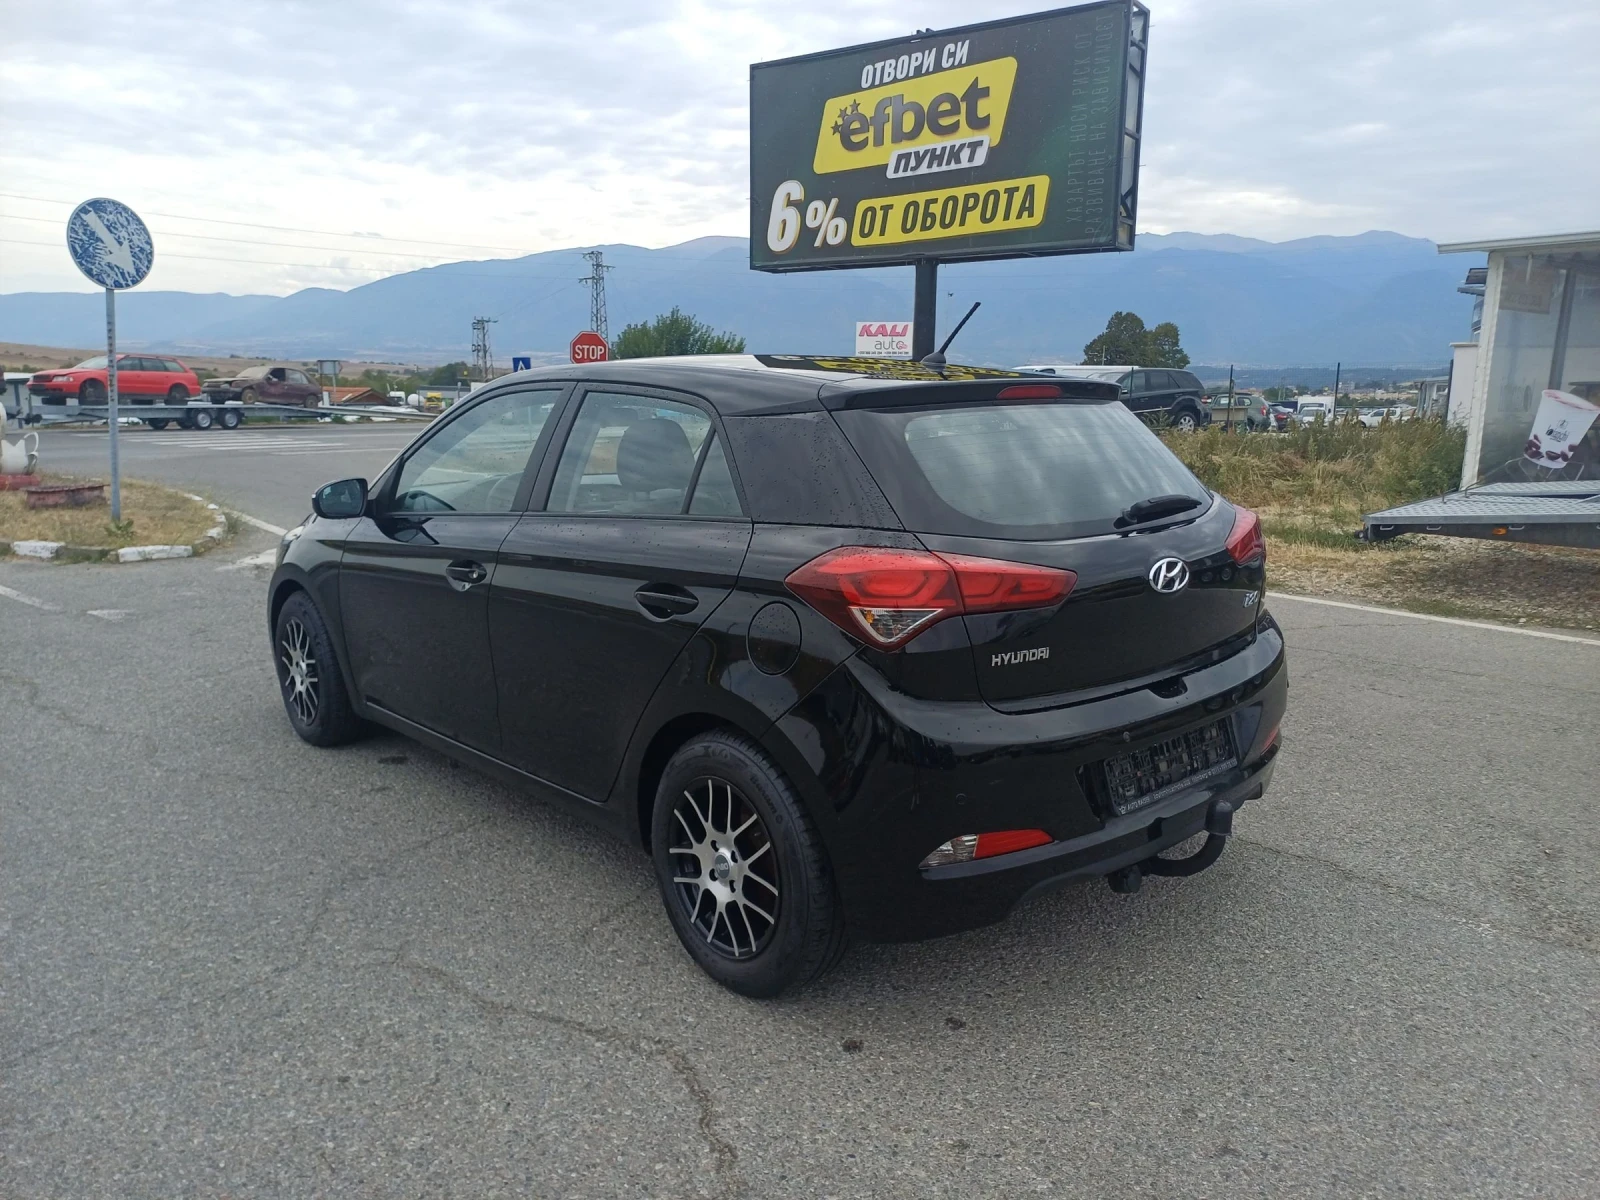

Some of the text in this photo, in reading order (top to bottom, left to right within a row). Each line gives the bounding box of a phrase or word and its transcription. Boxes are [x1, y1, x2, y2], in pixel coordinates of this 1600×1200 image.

[861, 40, 970, 89] ОТВОРИ СИ
[838, 77, 991, 152] efbet
[1066, 32, 1093, 223] ХАЗАРТЪТ НОСИ РИСК ОТ
[1085, 14, 1114, 234] РАЗВИВАНЕ НА ЗАВИСИМОСТ
[893, 140, 984, 174] ПУНКТ
[767, 179, 1037, 254] 6% ОТ ОБОРОТА
[858, 323, 909, 337] KALI
[874, 337, 906, 350] auto
[574, 344, 605, 360] STOP
[991, 646, 1050, 667] HYUNDAI
